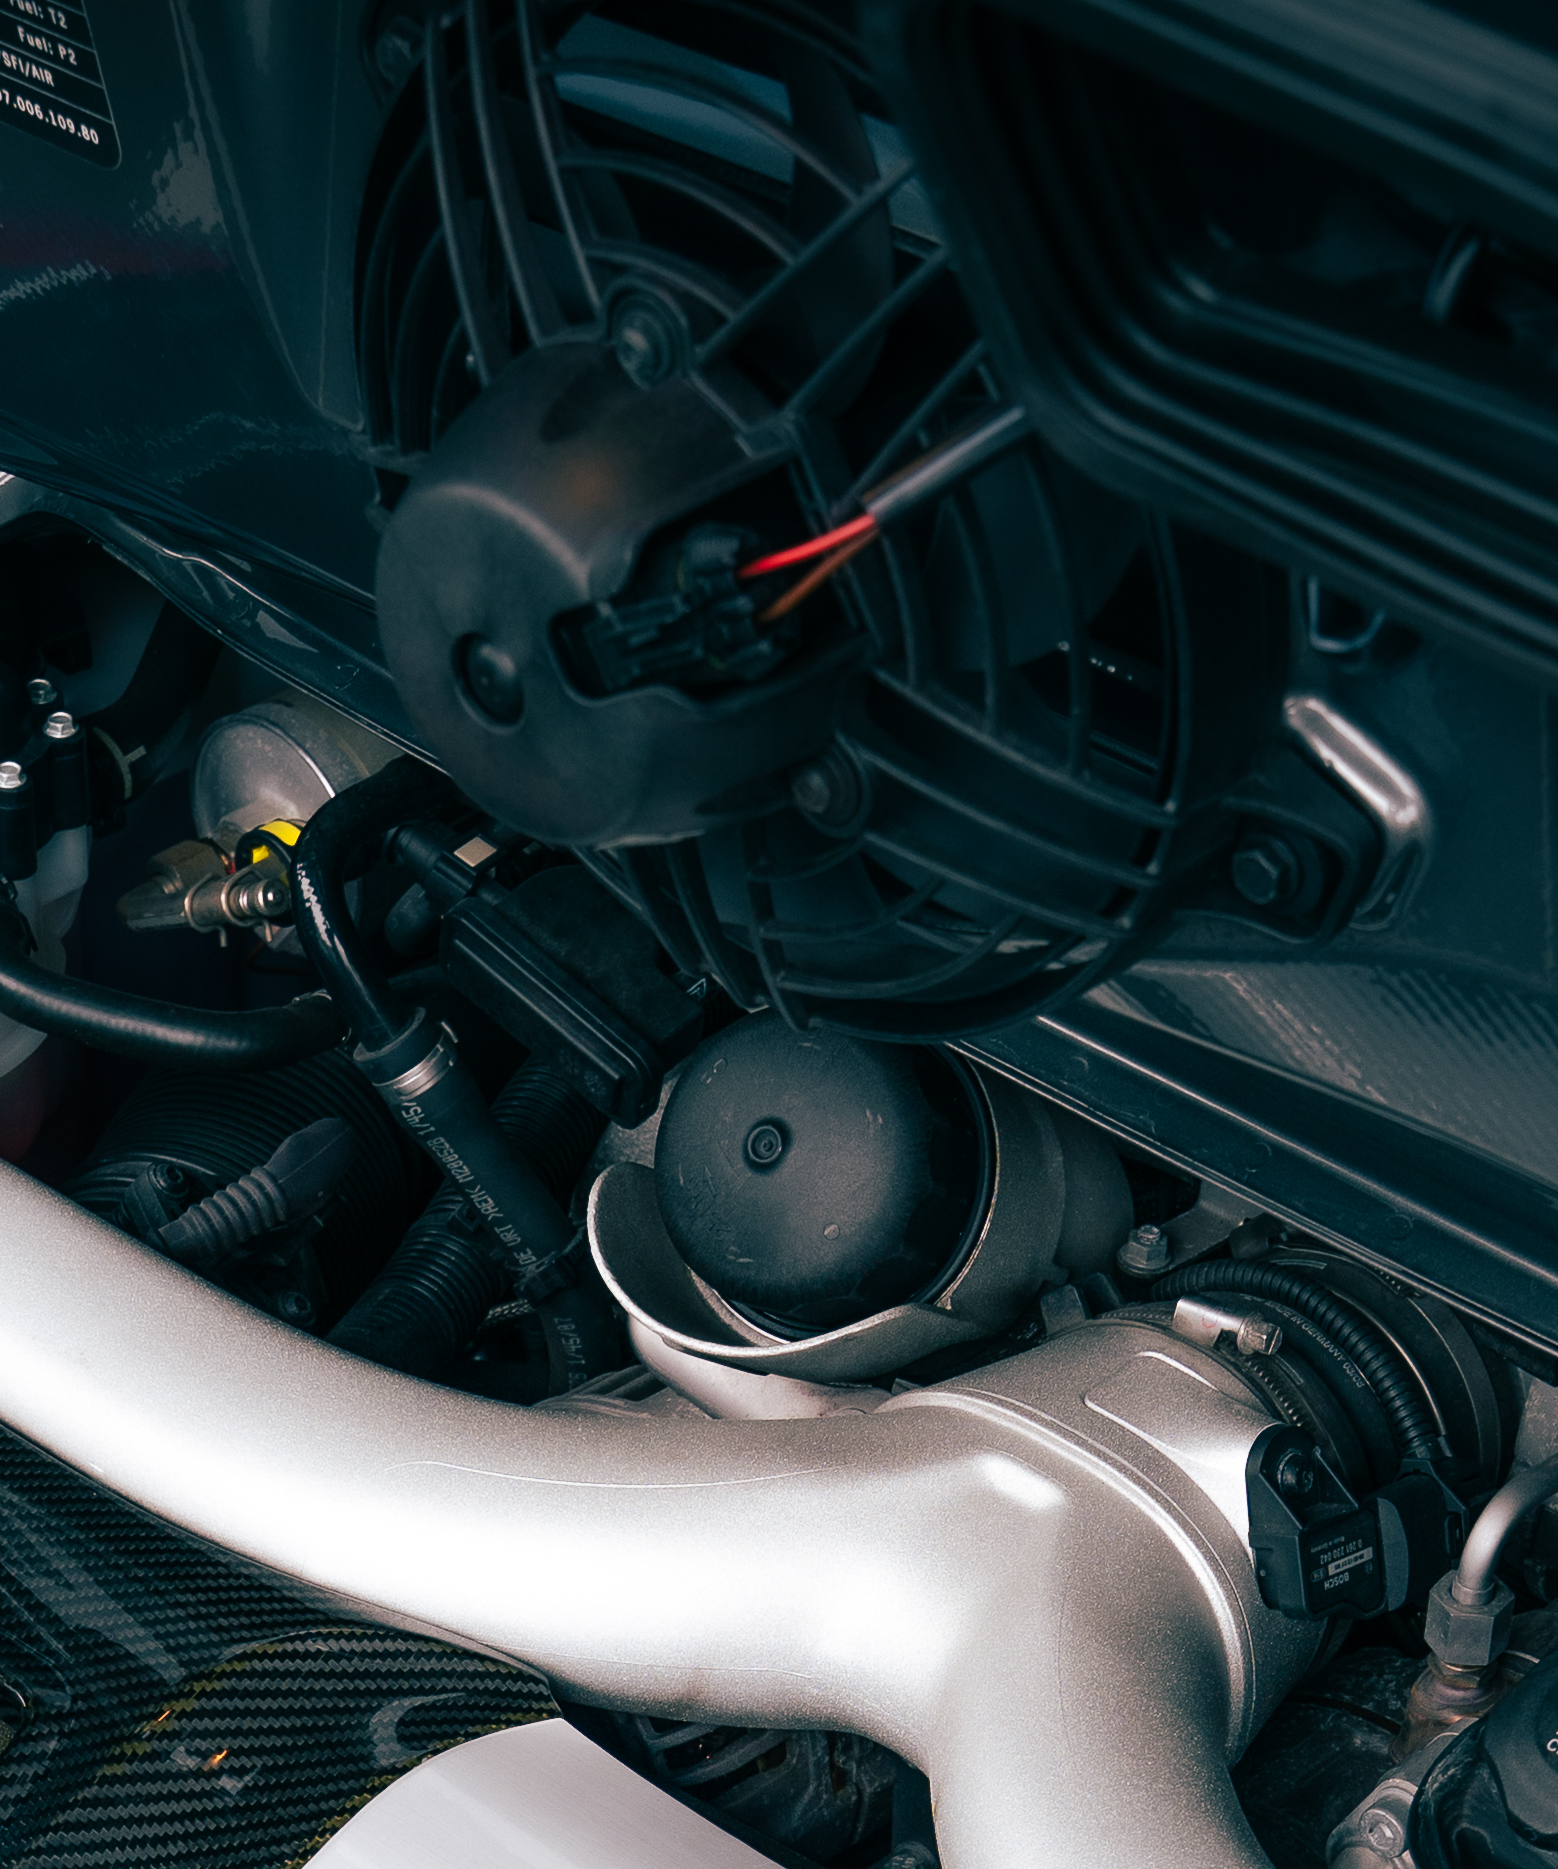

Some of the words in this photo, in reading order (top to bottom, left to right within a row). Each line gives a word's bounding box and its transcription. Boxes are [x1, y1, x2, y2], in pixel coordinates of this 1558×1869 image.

[47, 6, 69, 30] T2
[16, 24, 54, 56] Fuel:
[57, 43, 79, 66] P2
[1301, 1321, 1346, 1362] GERMANY
[1323, 1571, 1350, 1591] BOSCH
